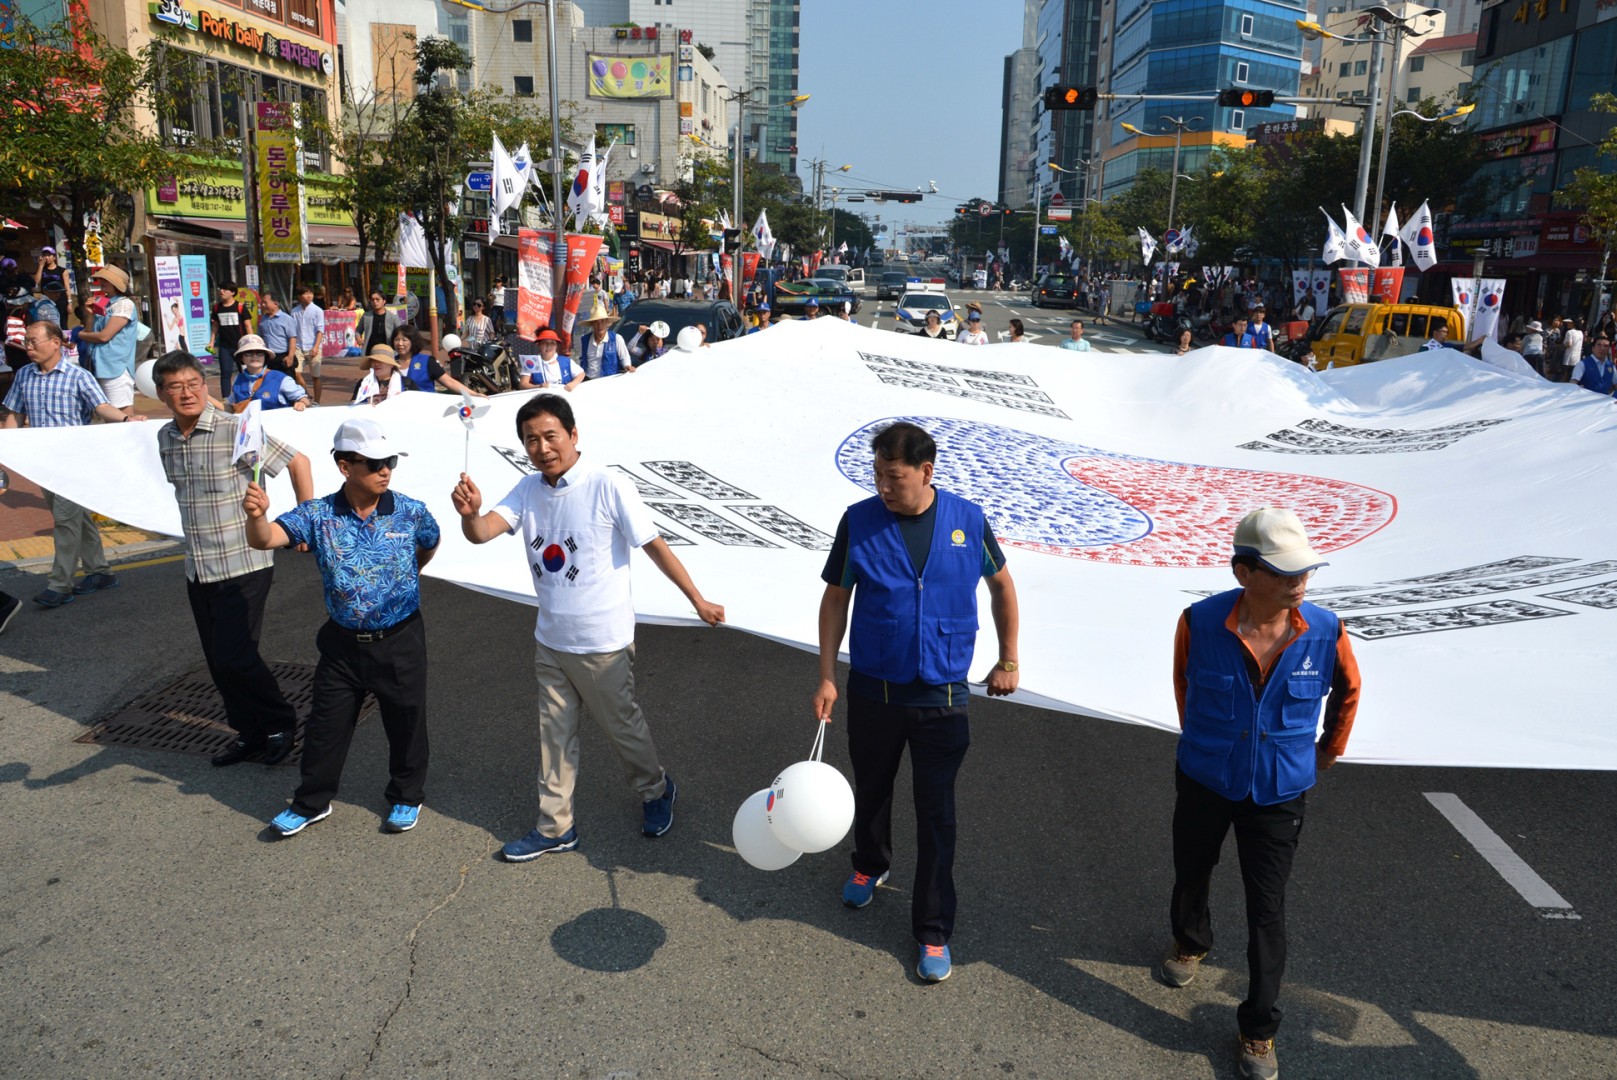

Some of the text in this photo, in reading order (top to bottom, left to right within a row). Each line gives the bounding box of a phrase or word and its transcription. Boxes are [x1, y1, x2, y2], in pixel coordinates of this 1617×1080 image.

[200, 11, 265, 53] Pork belly
[279, 39, 321, 71] 돼지갈비
[1514, 240, 1537, 252] BAR
